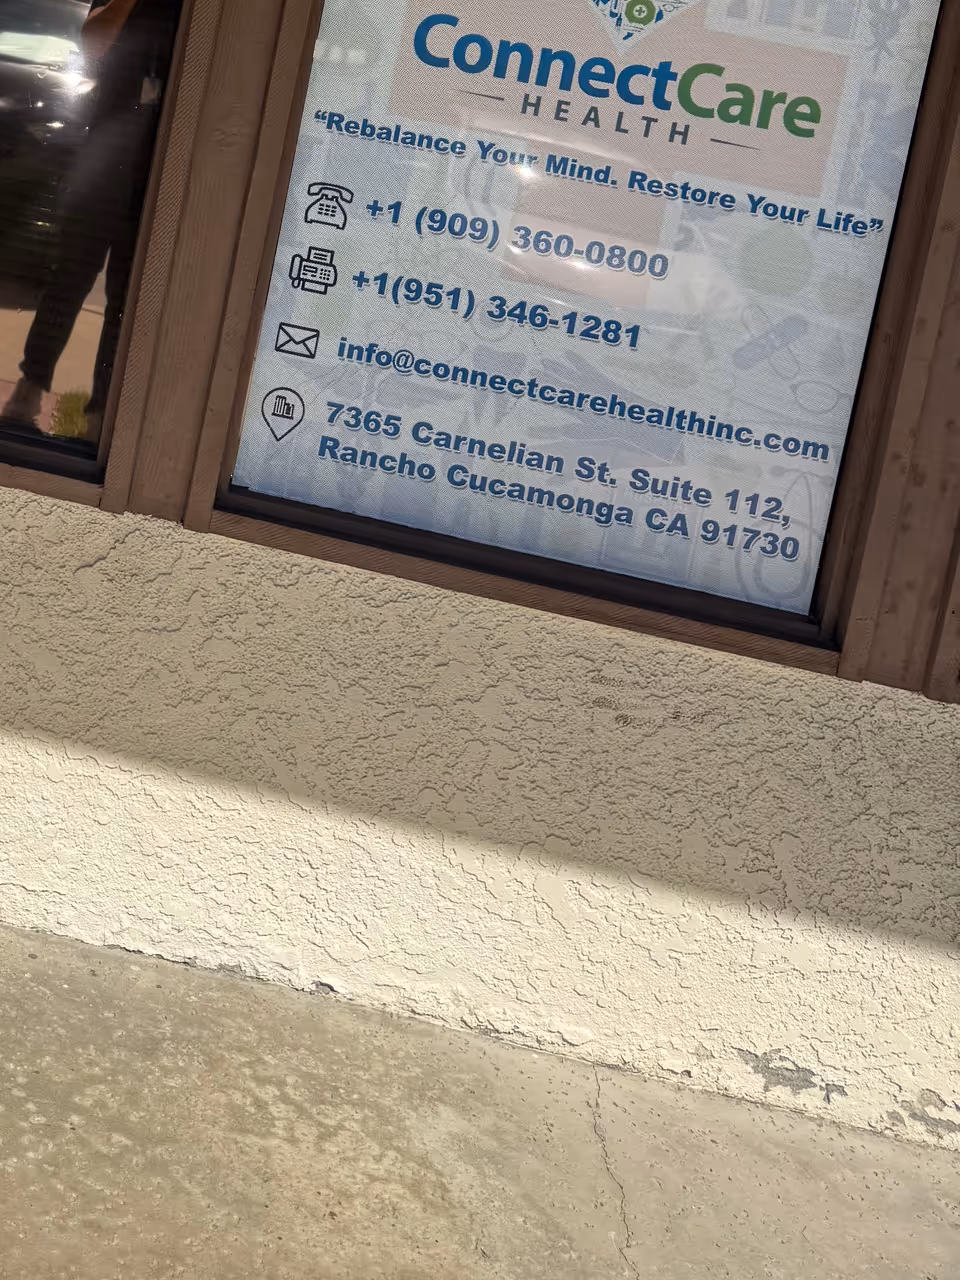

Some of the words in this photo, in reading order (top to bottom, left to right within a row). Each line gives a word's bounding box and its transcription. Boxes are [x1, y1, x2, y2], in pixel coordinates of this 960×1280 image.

[413, 14, 822, 139] ConnectCare
[520, 93, 690, 146] HEALTH
[313, 109, 468, 157] “Rebalance
[476, 140, 537, 167] Your
[545, 155, 618, 186] Mind.
[628, 170, 737, 211] Restore
[746, 193, 811, 224] Your
[816, 208, 884, 238] Life”
[366, 198, 403, 225] +1
[415, 207, 501, 250] (909)
[512, 223, 669, 279] 360-0800
[352, 270, 476, 320] +1(951)
[487, 296, 642, 350] 346-1281
[338, 336, 831, 461] info@connectcarehealthinc.com
[317, 436, 437, 483] Rancho
[446, 464, 635, 528] Cucamonga
[645, 507, 690, 539] CA
[700, 519, 801, 562] 91730
[325, 401, 403, 439] 7365
[412, 420, 565, 475] Carnelian
[575, 456, 619, 487] St.
[629, 468, 713, 507] Suite
[723, 488, 791, 528] 112,
